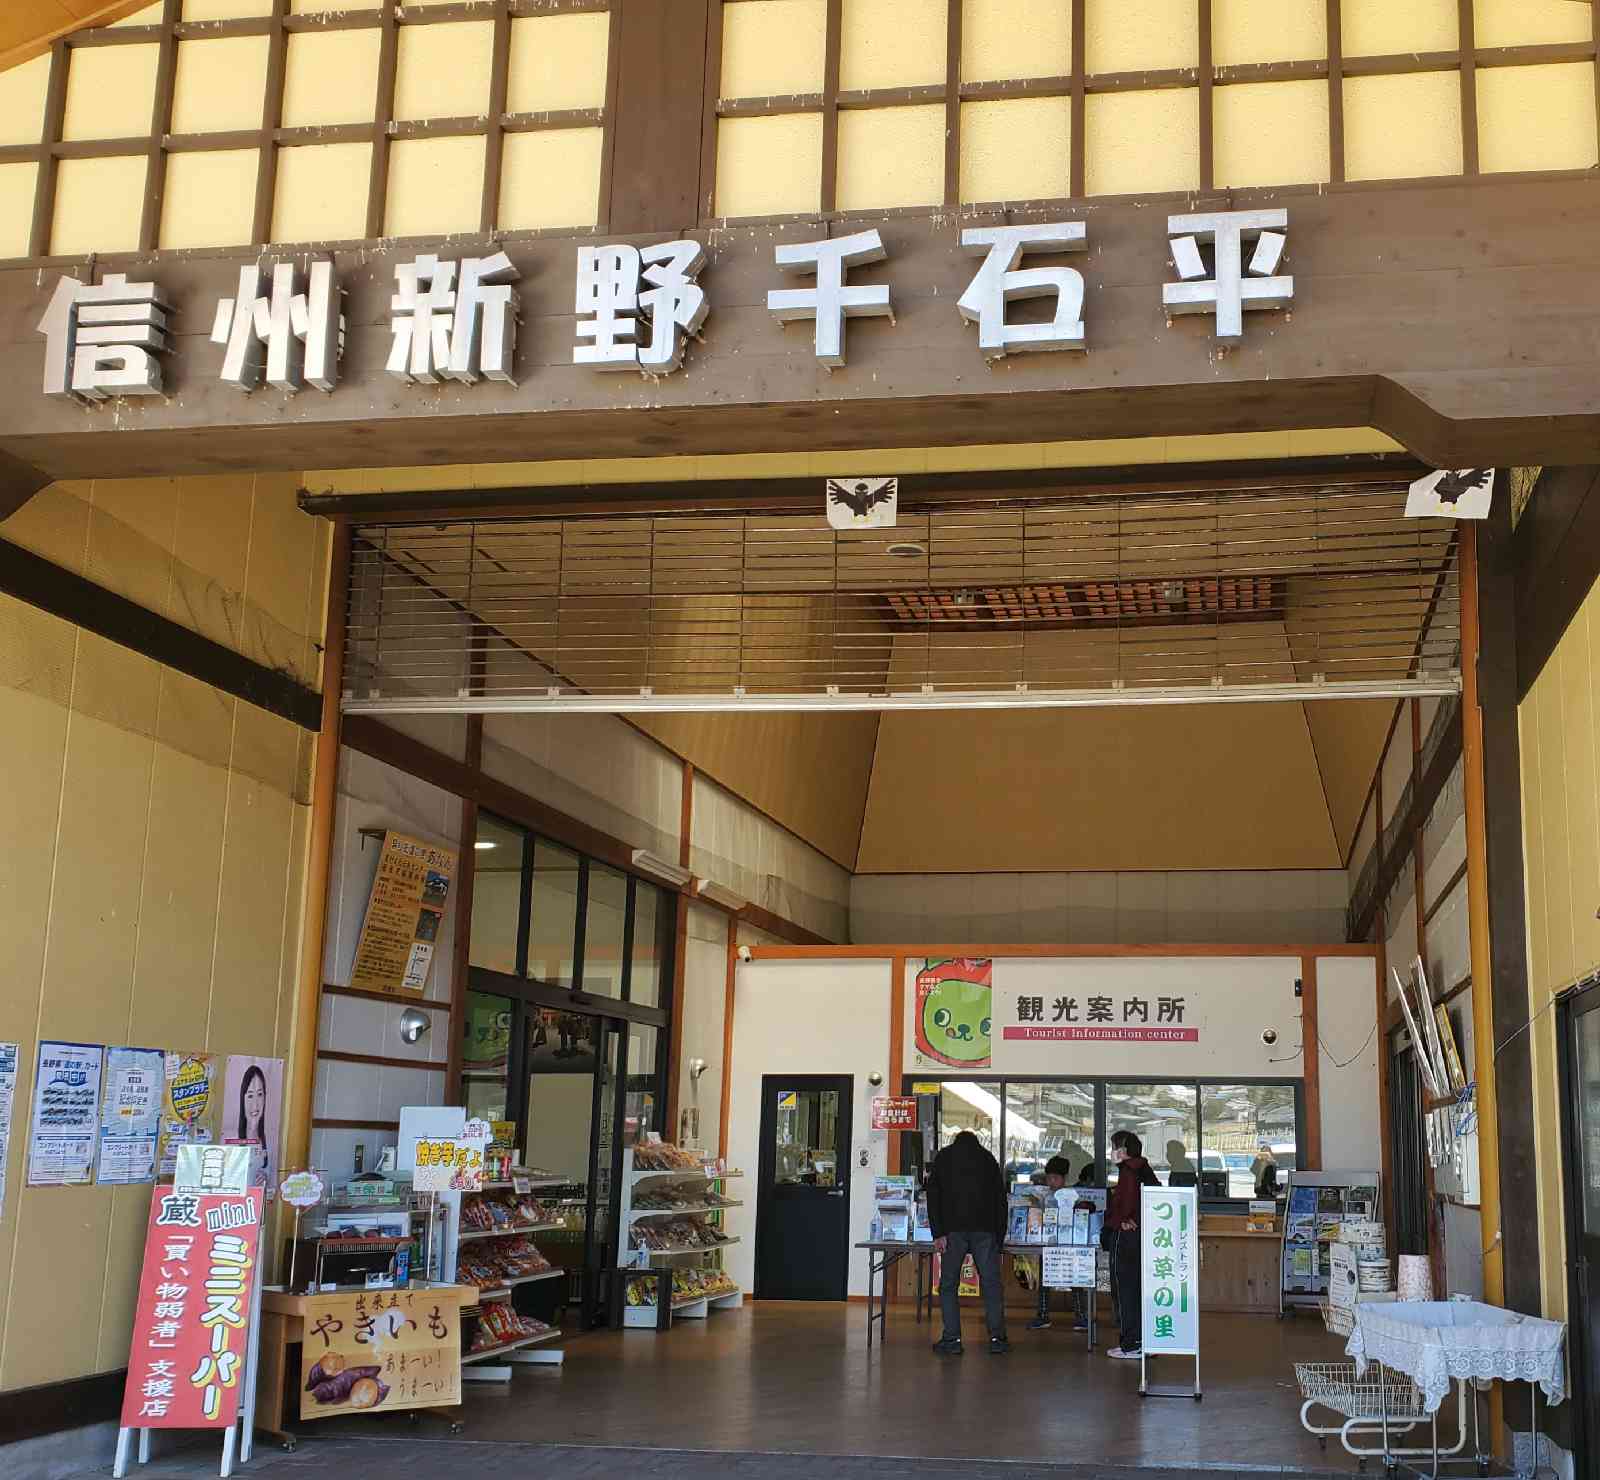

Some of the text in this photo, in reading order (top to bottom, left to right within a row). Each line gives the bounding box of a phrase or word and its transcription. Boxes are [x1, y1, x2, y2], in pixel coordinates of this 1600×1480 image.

[37, 207, 1294, 396] 信州新野千石平
[1017, 995, 1185, 1023] 観光案内所
[1024, 1027, 1185, 1040] Tourist Information center
[158, 1195, 202, 1226] 蔵
[206, 1197, 257, 1232] mini
[1152, 1202, 1175, 1338] つみ草の里
[1179, 1232, 1188, 1282] レストラン
[191, 1234, 252, 1420] ミニスーパー
[310, 1306, 447, 1347] やきいも
